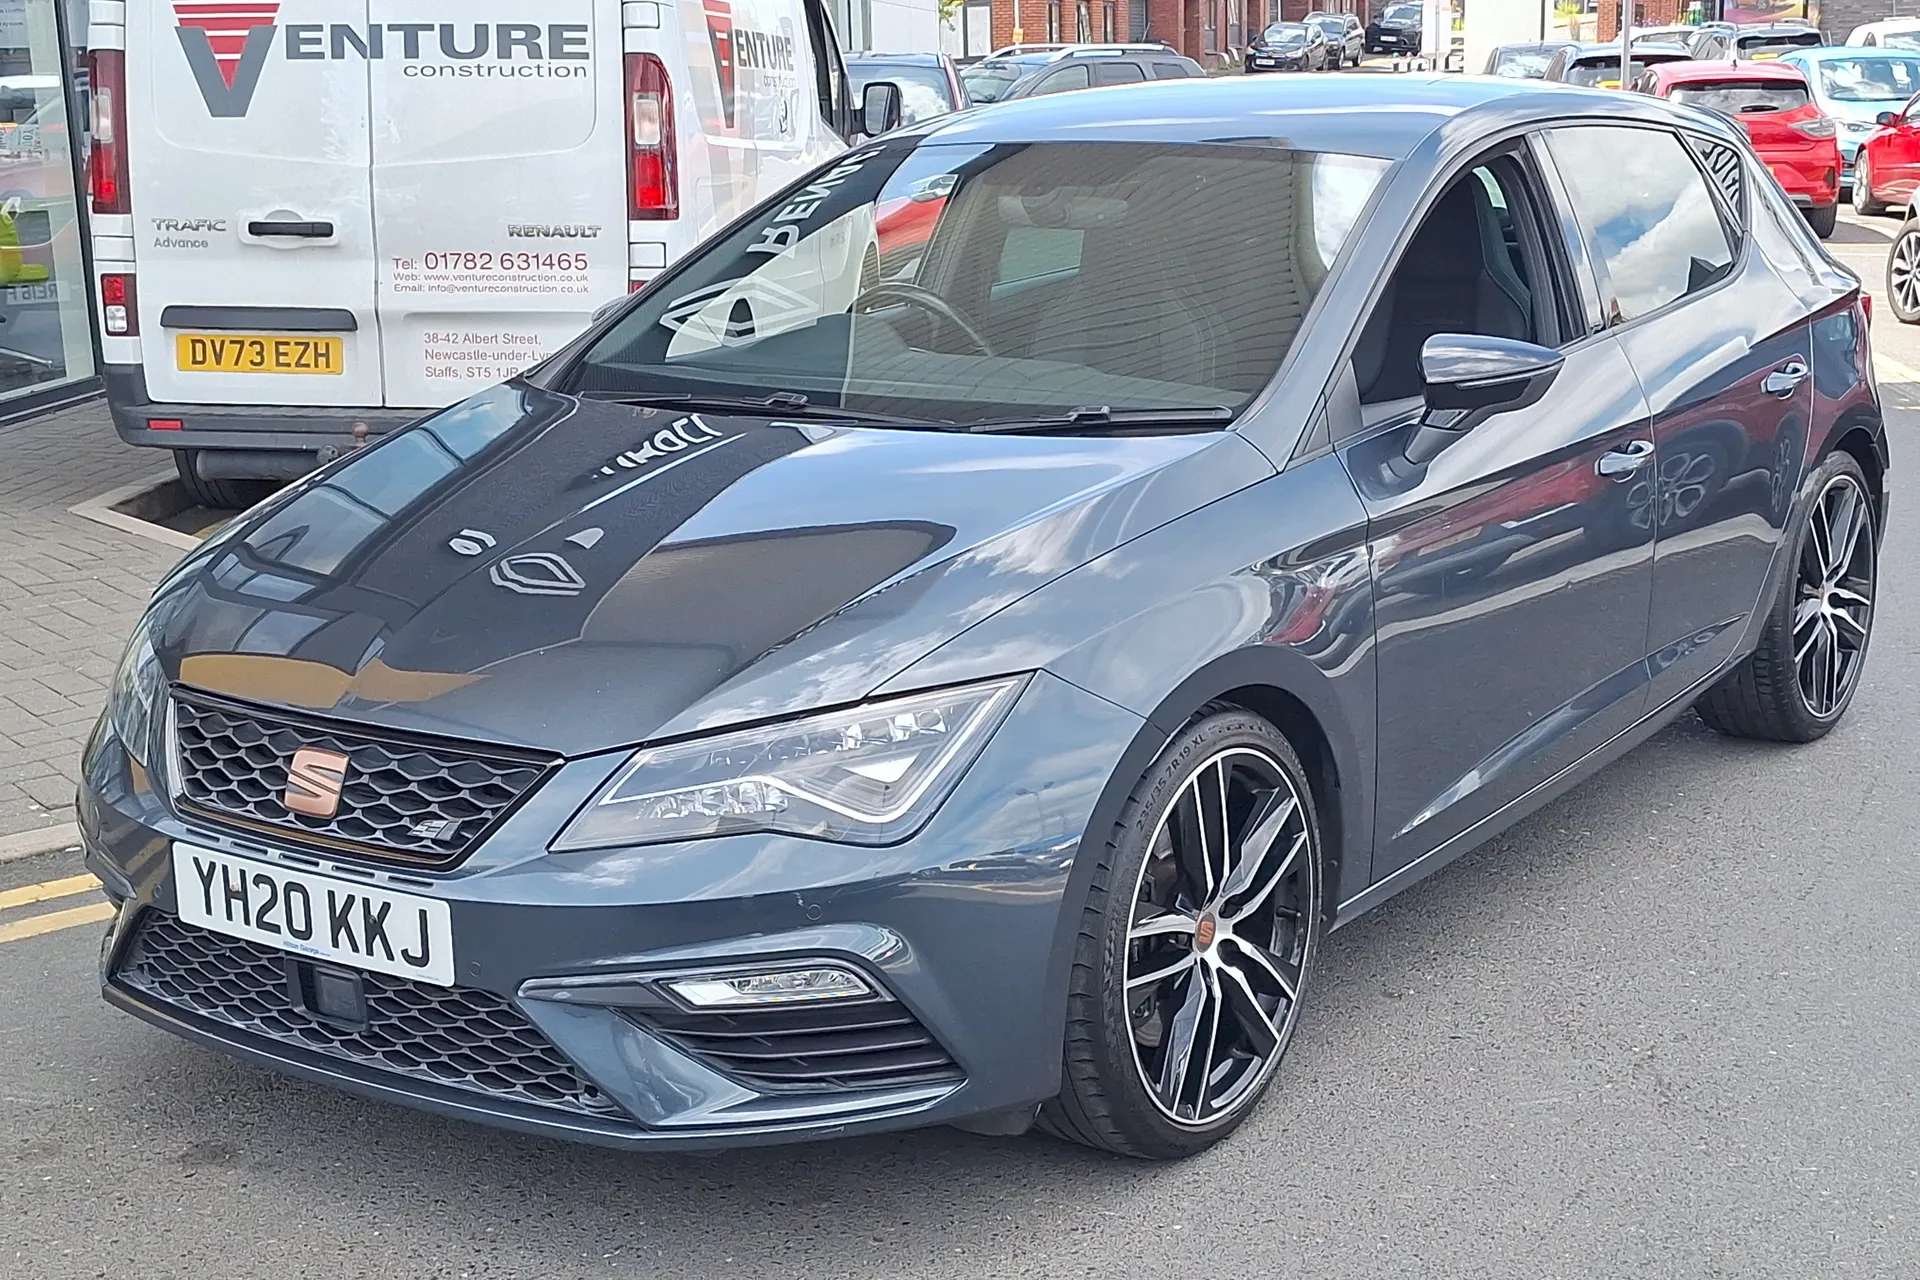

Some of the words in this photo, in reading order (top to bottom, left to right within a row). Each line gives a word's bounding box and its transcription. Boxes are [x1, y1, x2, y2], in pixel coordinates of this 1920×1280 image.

[174, 20, 590, 118] VENTURE
[403, 61, 588, 78] construction
[704, 16, 794, 128] VENTURE
[152, 218, 227, 232] TRAFIC
[507, 224, 602, 238] RENAULT
[153, 237, 208, 248] Advance
[392, 258, 418, 271] Tel:
[424, 252, 493, 270] 01782
[500, 252, 588, 271] 631465
[393, 272, 421, 282] Web:
[424, 272, 589, 282] www.ventureconstruction.co.uk
[394, 284, 426, 293] Email:
[424, 332, 459, 345] 38-42
[462, 333, 499, 345] Albert
[502, 333, 542, 346] Street,
[190, 338, 265, 367] DV73
[274, 340, 331, 369] EZH
[425, 366, 463, 379] Staffs,
[466, 366, 492, 378] ST5
[192, 856, 313, 941] YH20
[327, 888, 430, 968] KKJ
